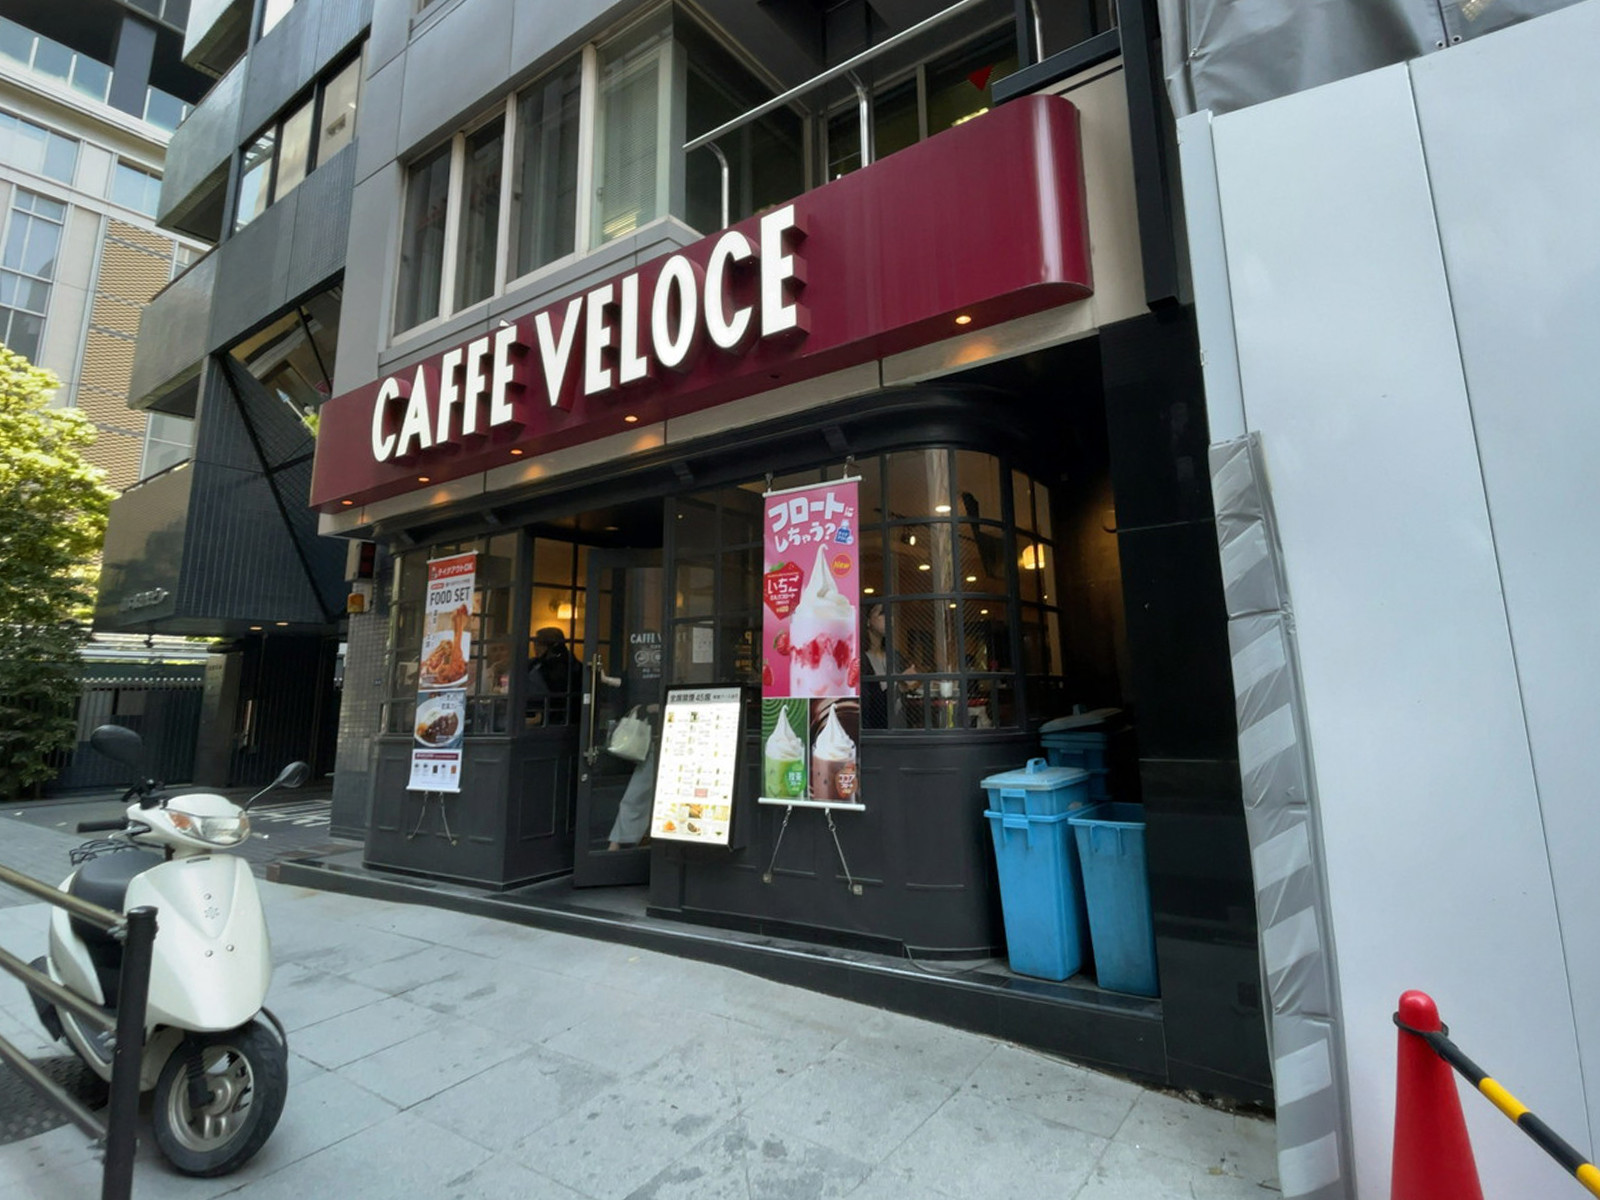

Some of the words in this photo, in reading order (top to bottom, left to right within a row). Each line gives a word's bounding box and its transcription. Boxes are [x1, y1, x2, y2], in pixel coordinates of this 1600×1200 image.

[371, 319, 518, 463] CAFFÈ
[534, 204, 798, 407] VELOCE
[833, 561, 850, 569] New
[767, 575, 799, 594] いちご
[430, 590, 452, 605] FOOD
[454, 586, 470, 602] SET
[839, 774, 855, 783] ココア
